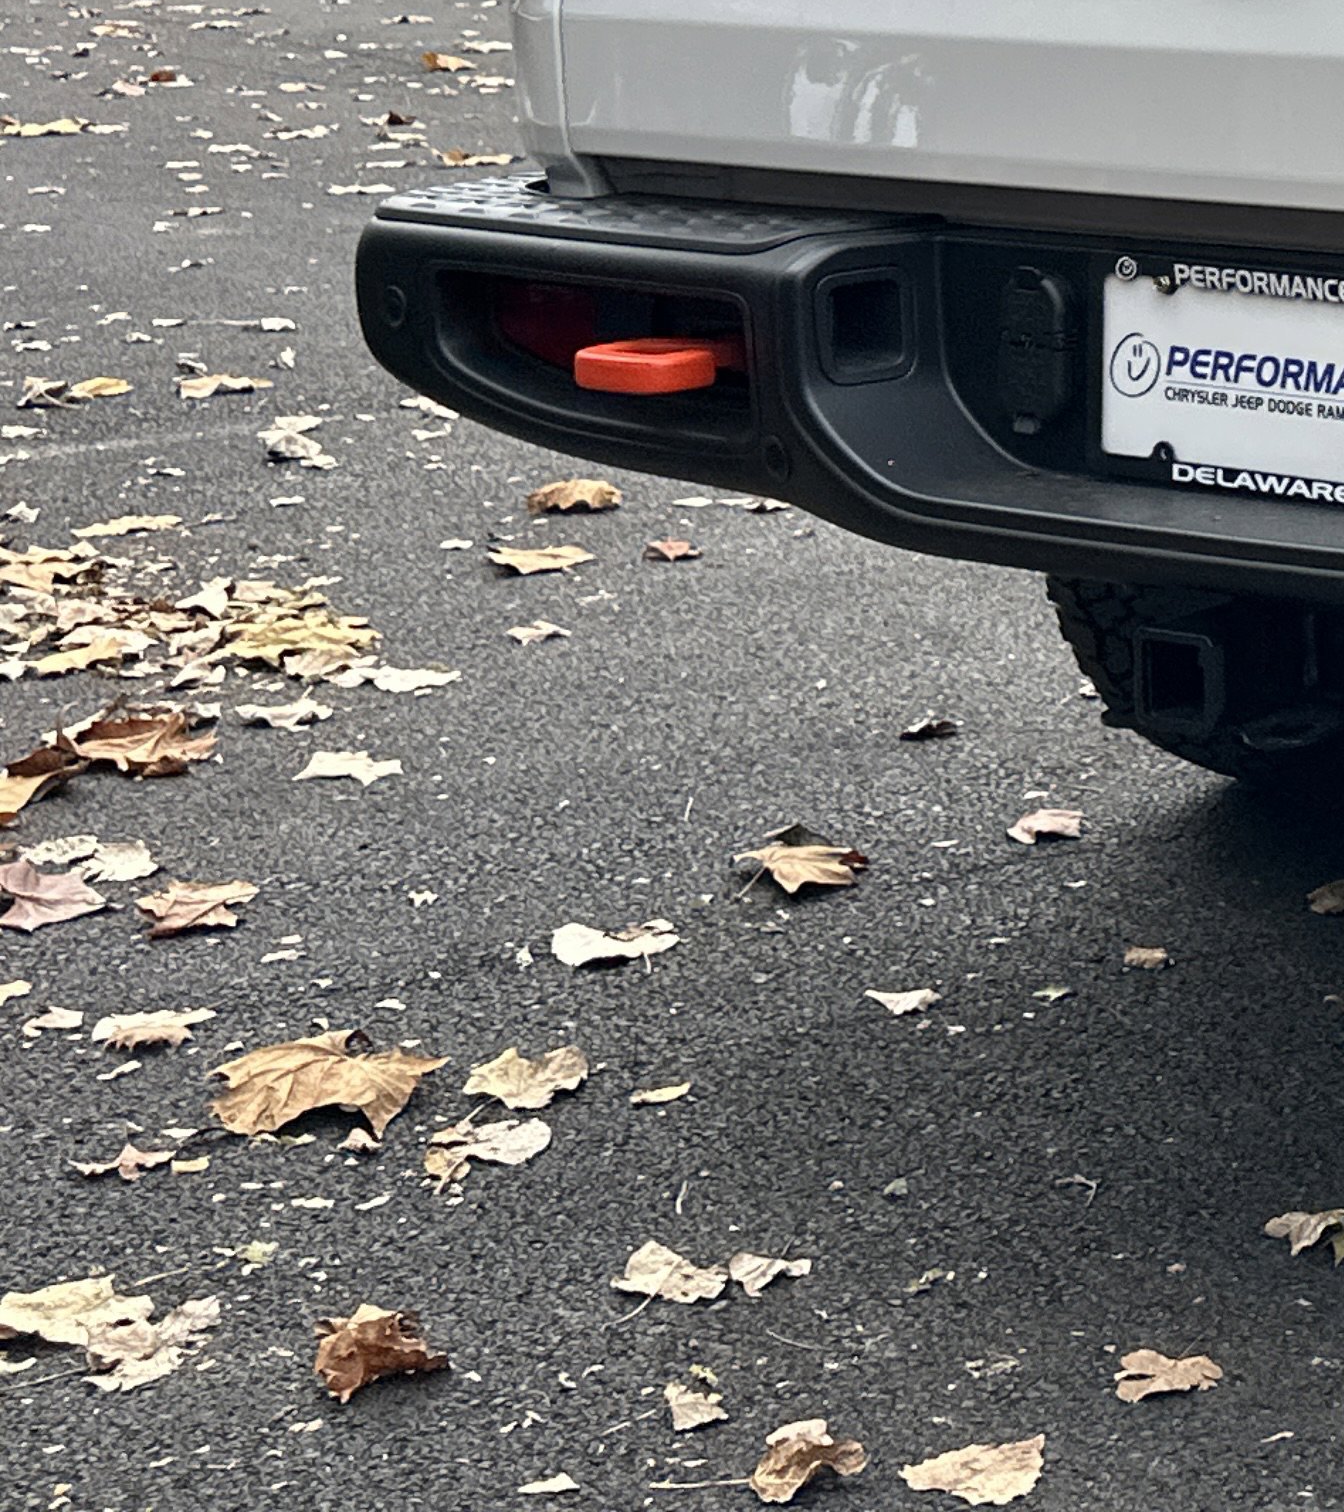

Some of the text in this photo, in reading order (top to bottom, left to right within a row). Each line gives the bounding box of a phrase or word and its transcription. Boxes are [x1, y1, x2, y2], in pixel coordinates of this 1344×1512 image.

[1164, 386, 1228, 408] CHRYSLER
[1231, 393, 1264, 411] JEEP
[1268, 399, 1313, 417] DODGE
